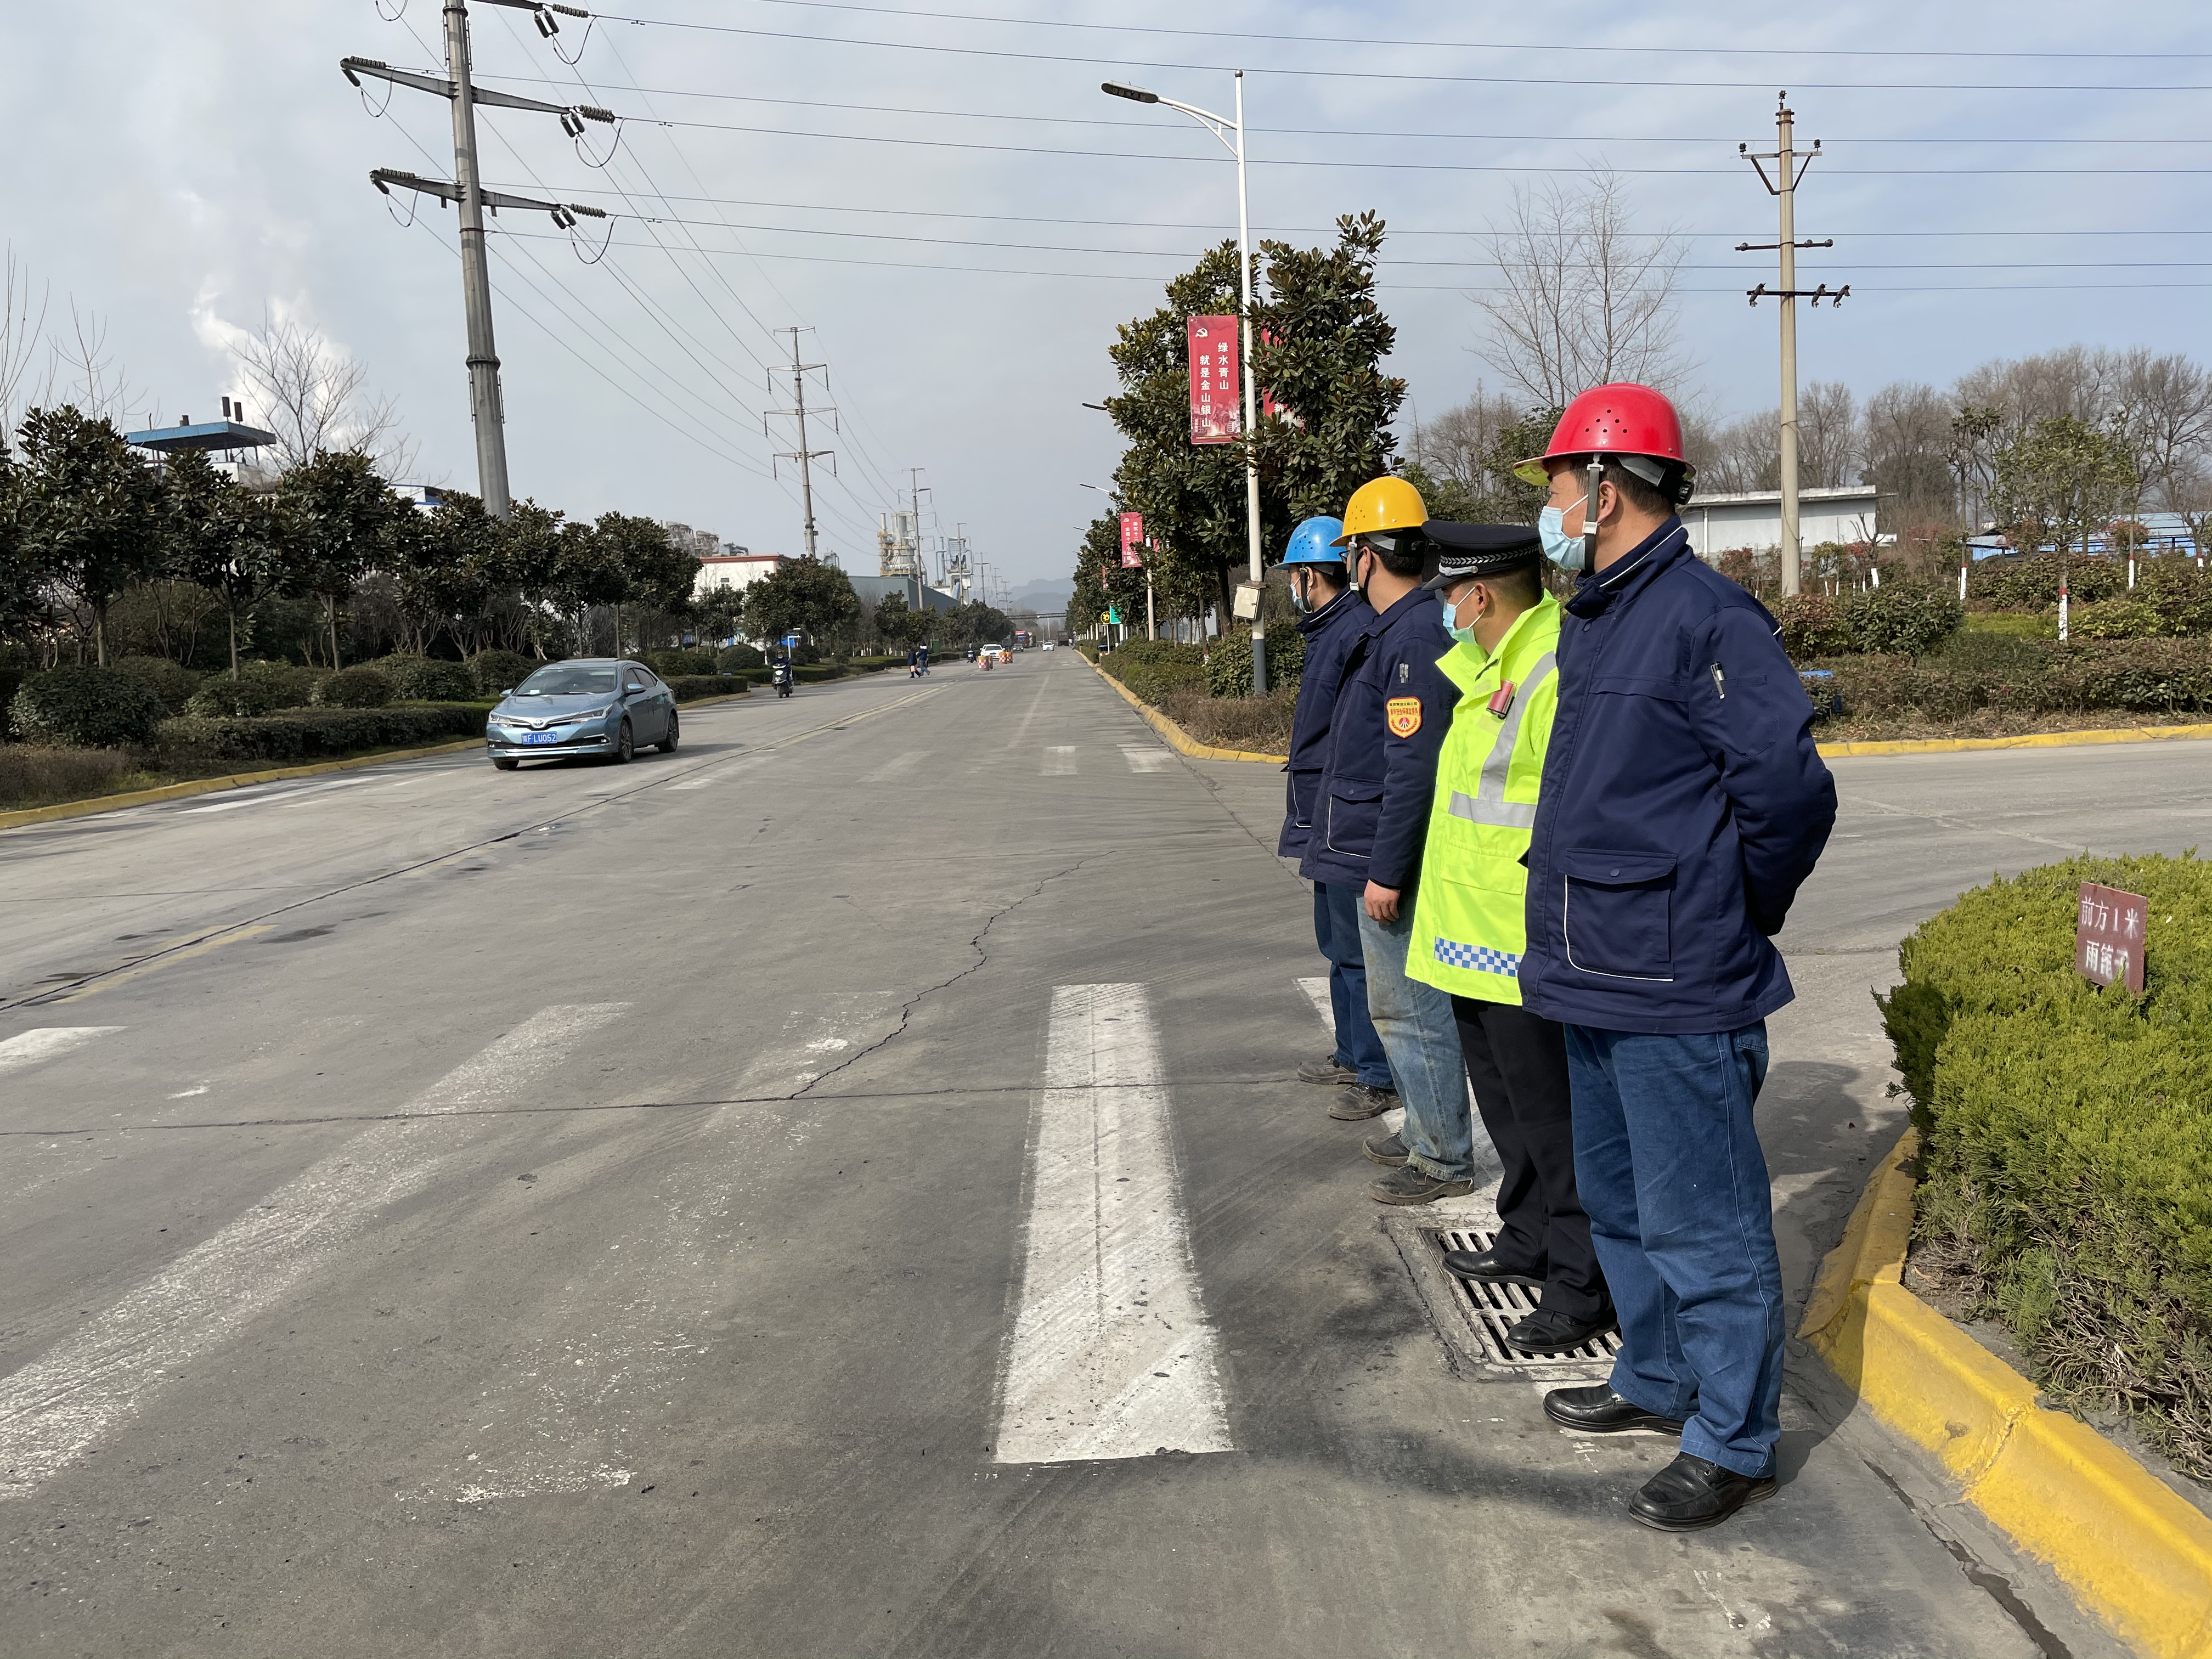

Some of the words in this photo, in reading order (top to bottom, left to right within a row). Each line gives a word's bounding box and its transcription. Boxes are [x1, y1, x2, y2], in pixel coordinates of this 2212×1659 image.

[1217, 342, 1229, 390] 绿水青山
[1199, 355, 1211, 427] 就是金山银山
[2081, 895, 2139, 940] 前方1米
